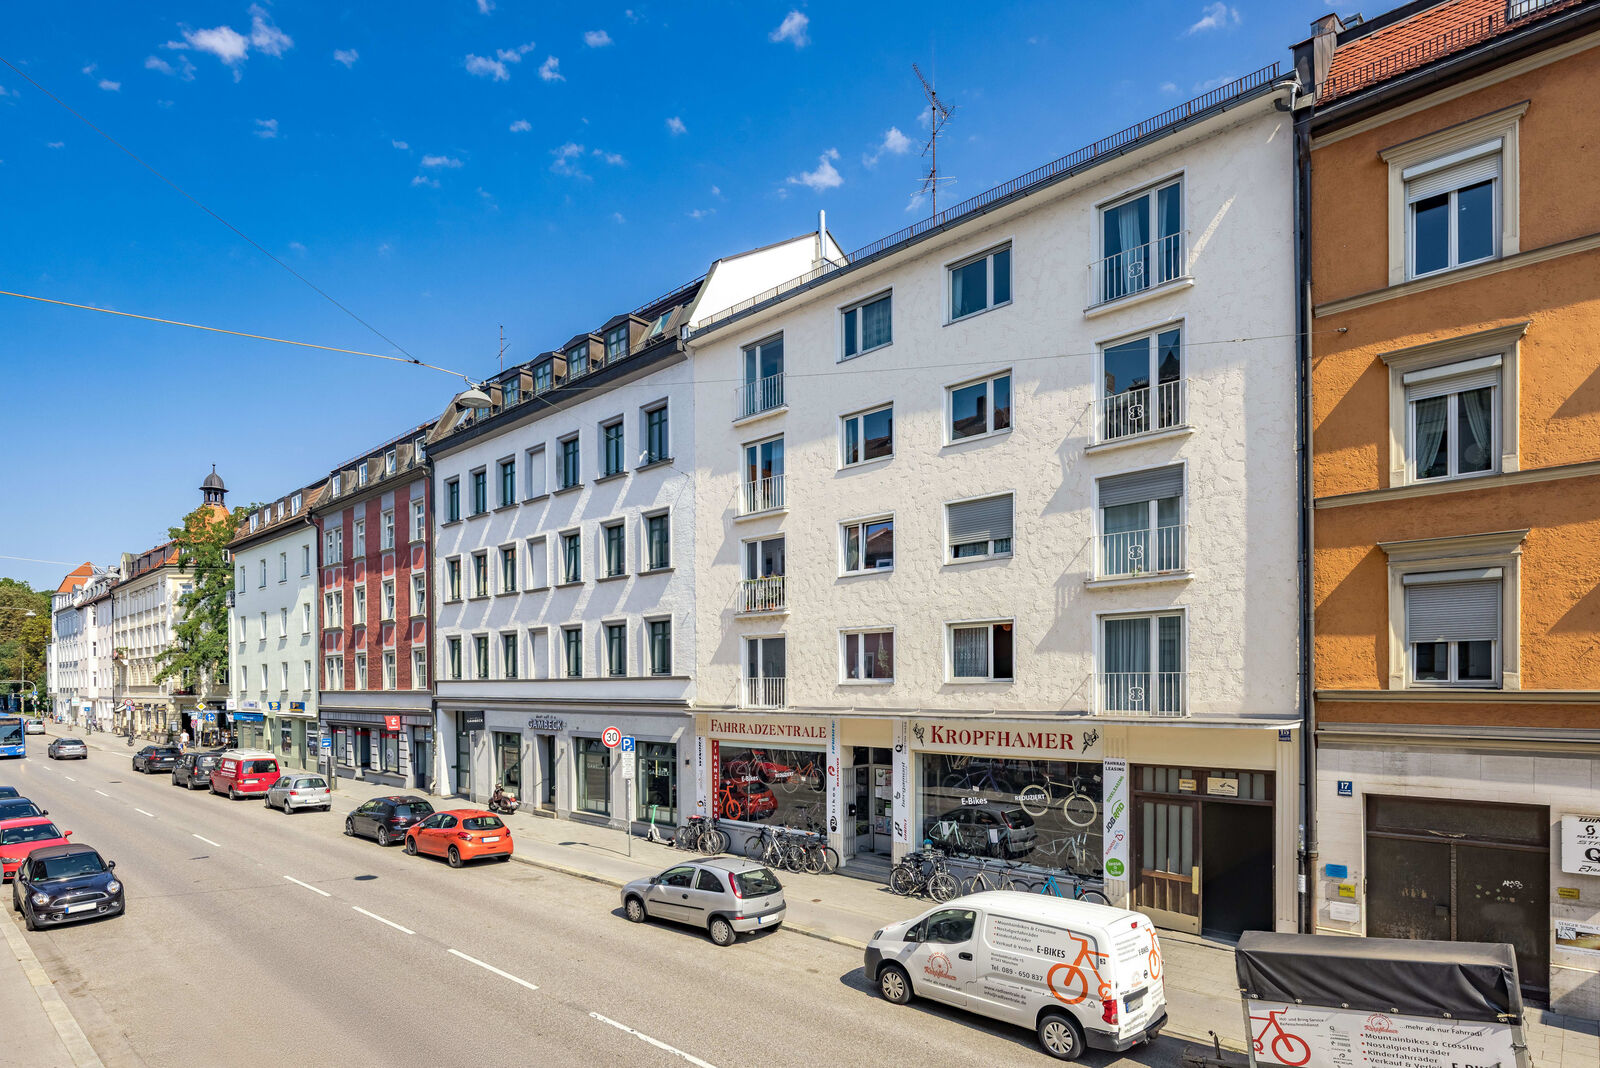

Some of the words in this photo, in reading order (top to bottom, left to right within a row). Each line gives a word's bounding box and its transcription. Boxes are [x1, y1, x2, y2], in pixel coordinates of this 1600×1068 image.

[528, 719, 564, 730] GAMBECK
[710, 719, 827, 738] FAHRRADZENTRALE
[606, 732, 618, 742] 30
[930, 725, 1074, 750] KROPFHAMER
[623, 738, 631, 750] P
[961, 796, 988, 805] E-Bikes
[1014, 794, 1045, 802] REDUZIERT
[1036, 946, 1066, 958] E-BIKES
[1002, 966, 1013, 974] 089
[1365, 1033, 1430, 1045] Mountainbikes
[1442, 1042, 1484, 1052] Crossline
[1369, 1057, 1402, 1066] Verkauf
